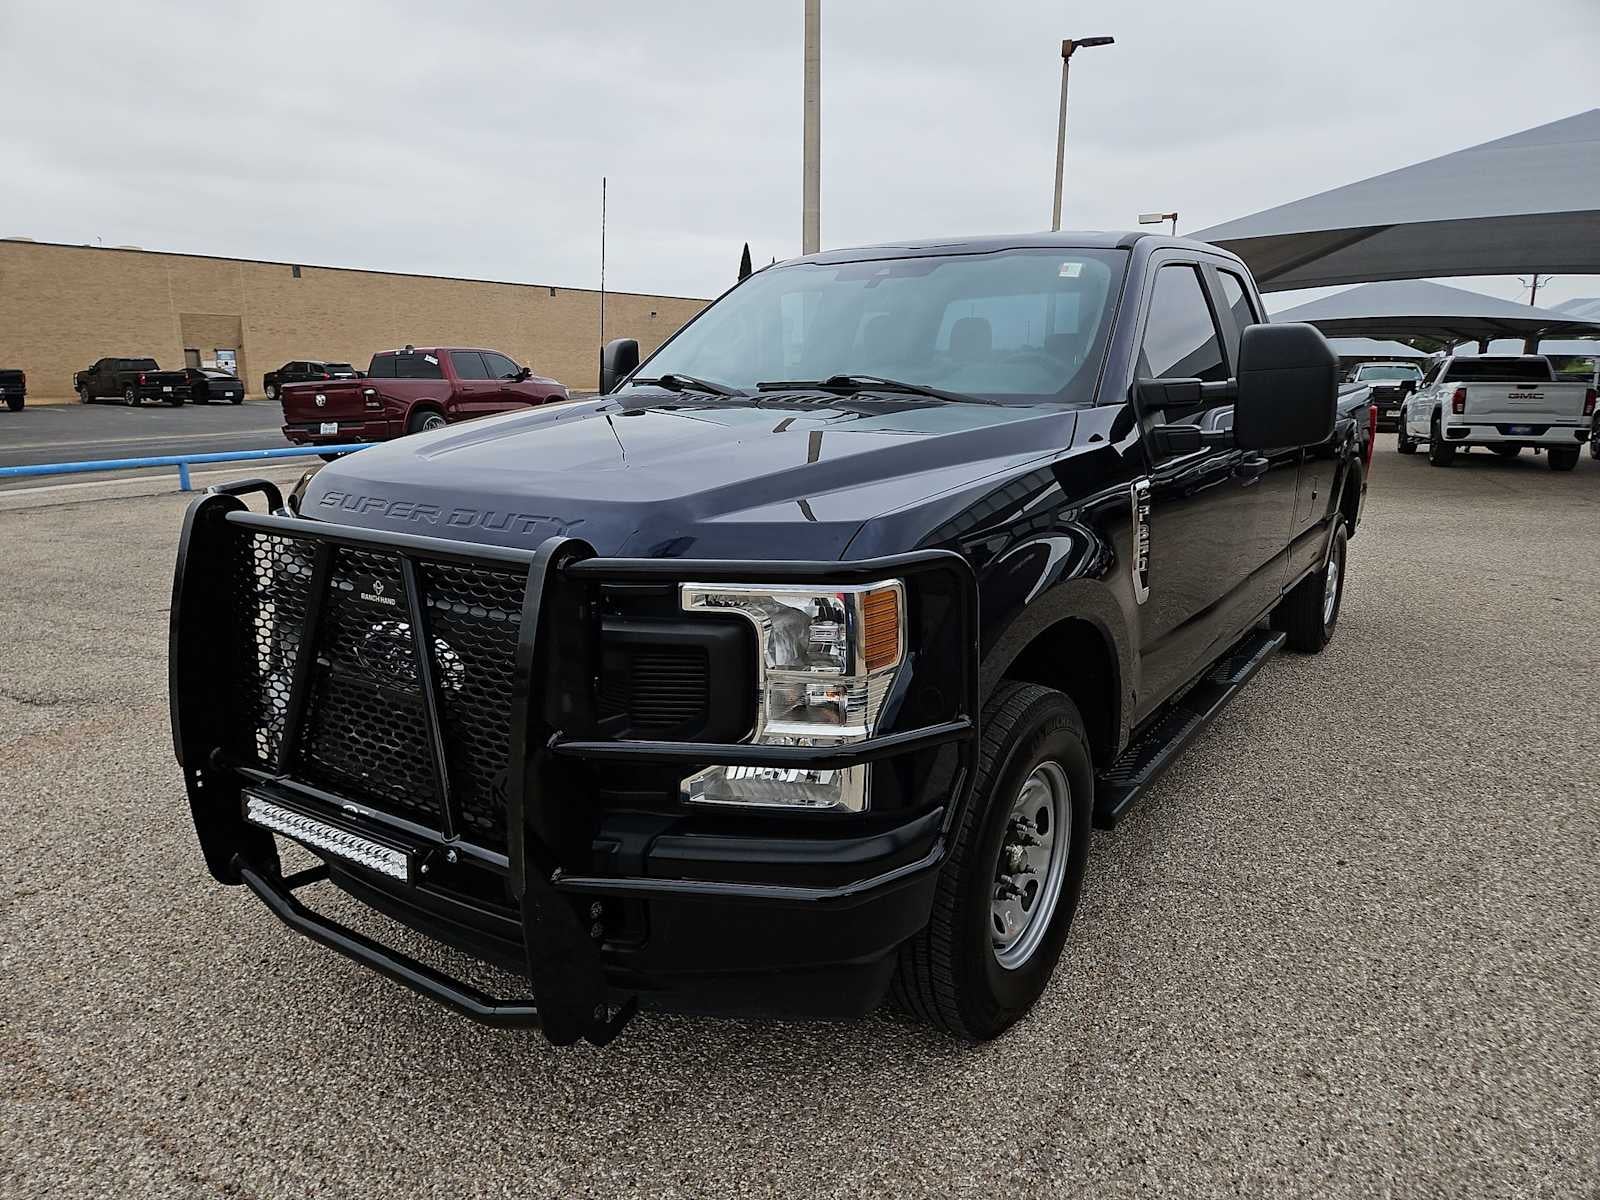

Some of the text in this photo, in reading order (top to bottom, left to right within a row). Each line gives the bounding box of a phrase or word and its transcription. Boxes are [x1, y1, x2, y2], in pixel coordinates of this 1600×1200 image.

[320, 491, 585, 537] SUPER DUTY
[361, 592, 396, 606] RANCH HAND
